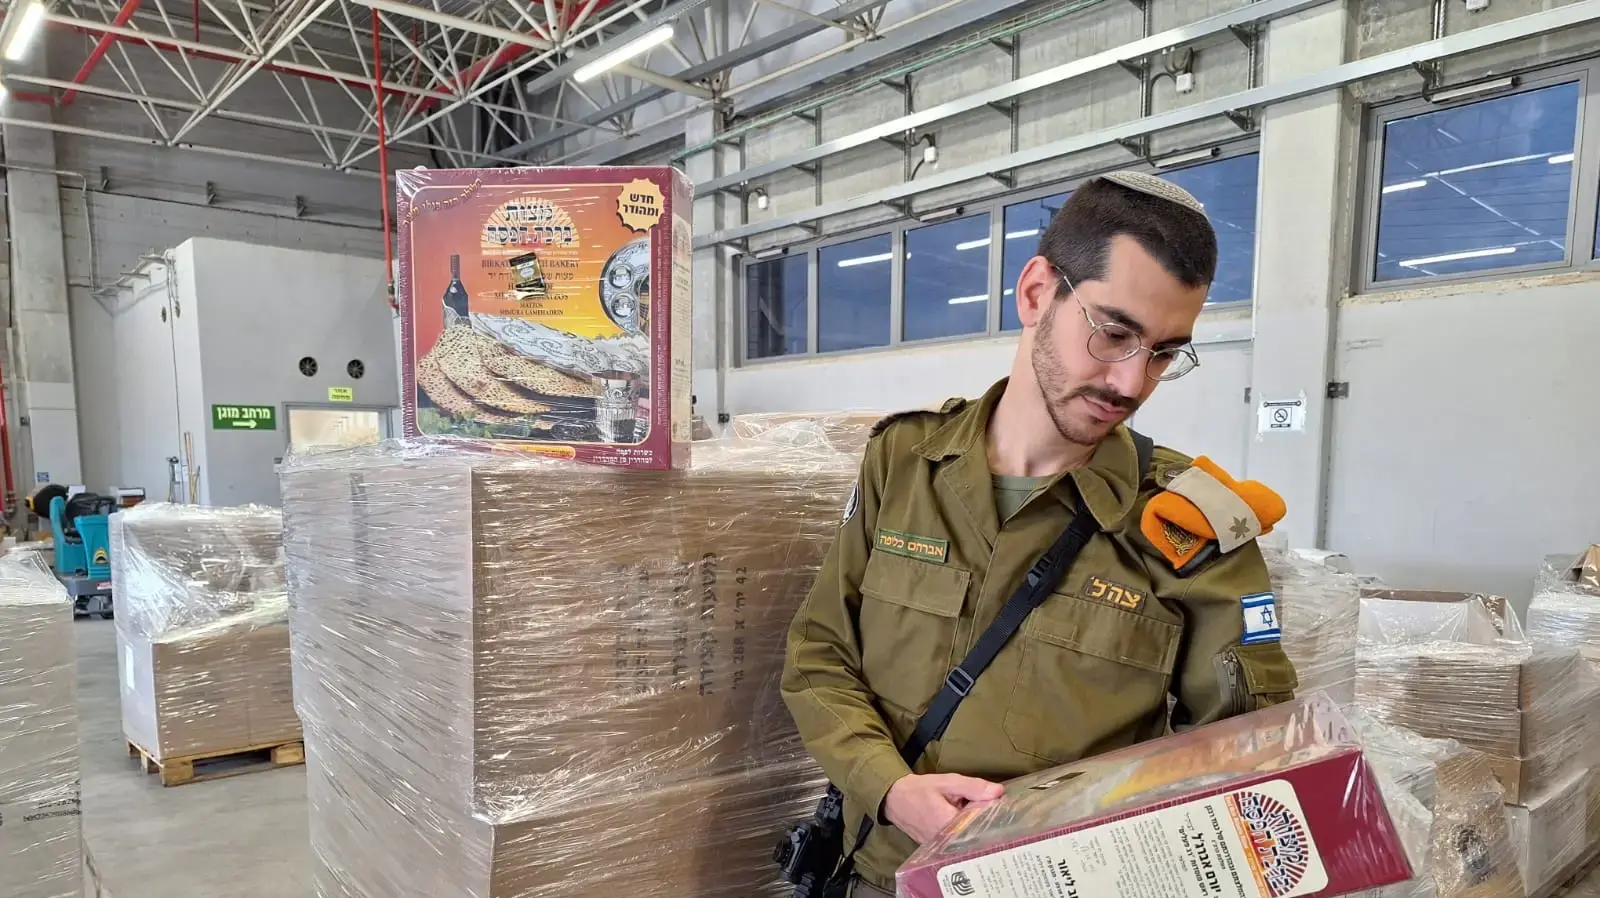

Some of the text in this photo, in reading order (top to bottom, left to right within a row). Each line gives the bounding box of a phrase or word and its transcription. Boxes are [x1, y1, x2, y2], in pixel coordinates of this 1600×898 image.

[630, 193, 654, 204] חדש
[505, 205, 553, 221] מצות
[623, 204, 659, 216] ומהודר
[549, 260, 579, 268] BAKERY
[217, 407, 271, 420] מרחב מוגן
[880, 535, 944, 556] אברהם כליפה
[736, 566, 747, 584] 42
[1215, 830, 1225, 840] של
[1240, 796, 1291, 888] ברכת הפסח
[1270, 810, 1304, 864] מצות
[1191, 832, 1221, 893] יורם אברג'ל
[1056, 858, 1075, 887] ליאור
[1198, 882, 1208, 896] ראש
[1231, 869, 1246, 898] המלצתם
